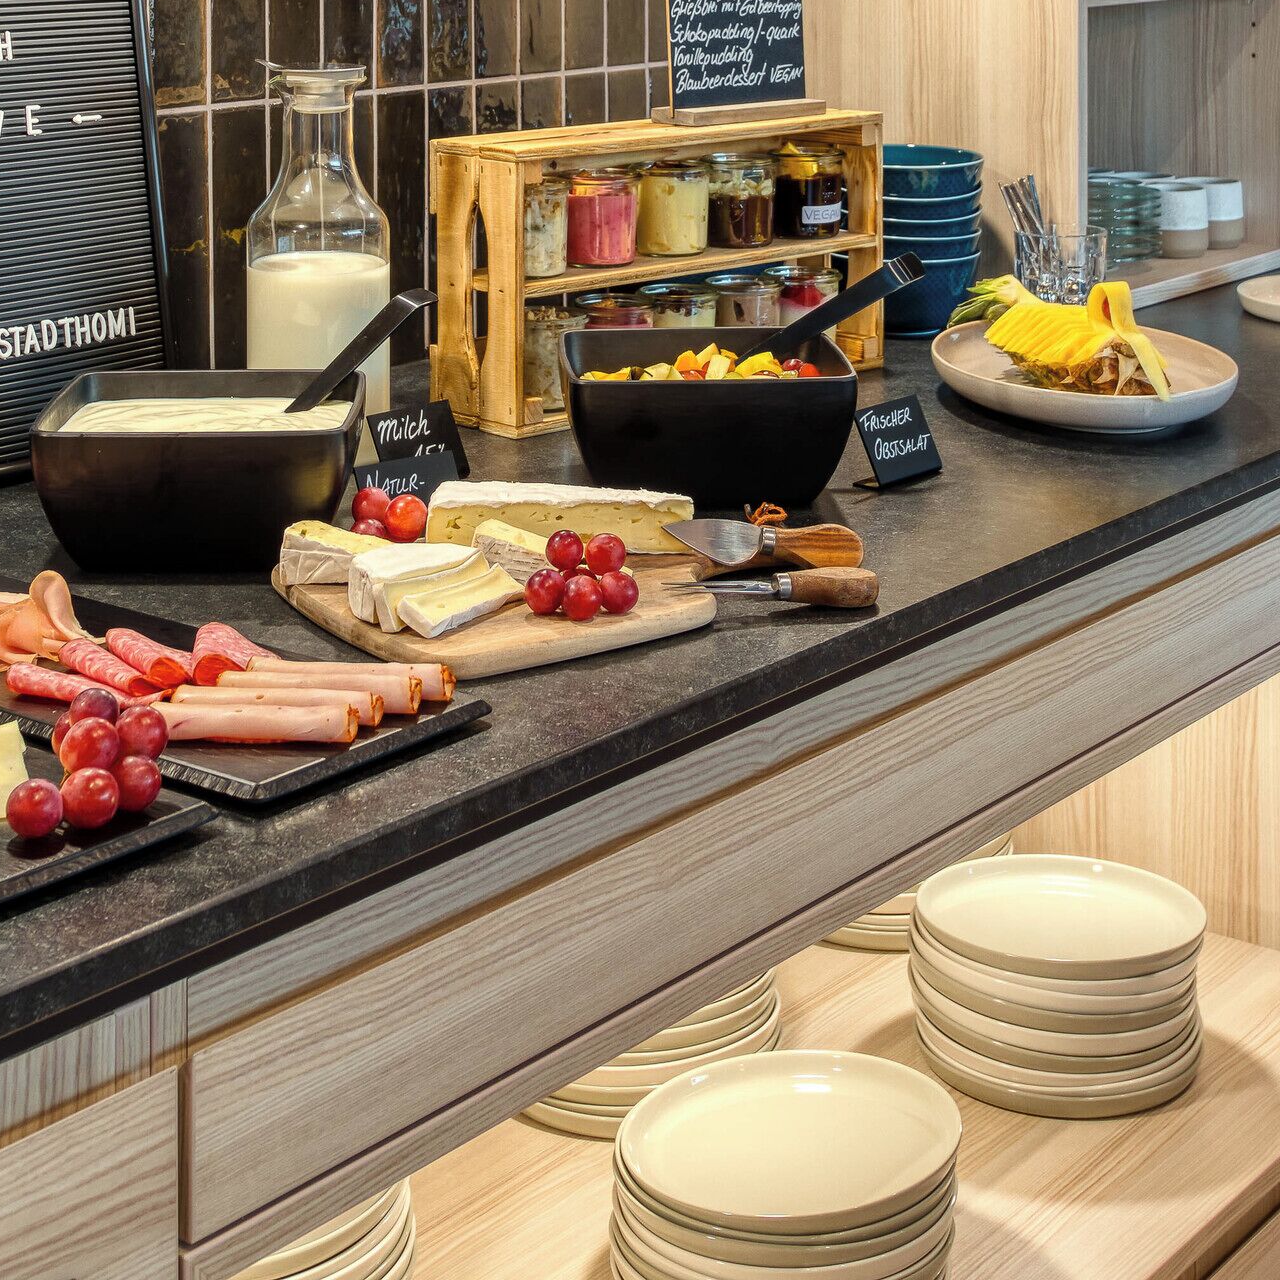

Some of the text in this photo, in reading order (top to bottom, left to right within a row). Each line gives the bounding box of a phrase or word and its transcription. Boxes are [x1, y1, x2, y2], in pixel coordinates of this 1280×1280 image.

[672, 45, 754, 73] Vanillepudding
[675, 63, 804, 94] Blaubeerdessert VEGAN
[377, 409, 431, 445] Milch
[859, 407, 913, 432] FRISCHER
[874, 433, 931, 461] OBSTSALAT
